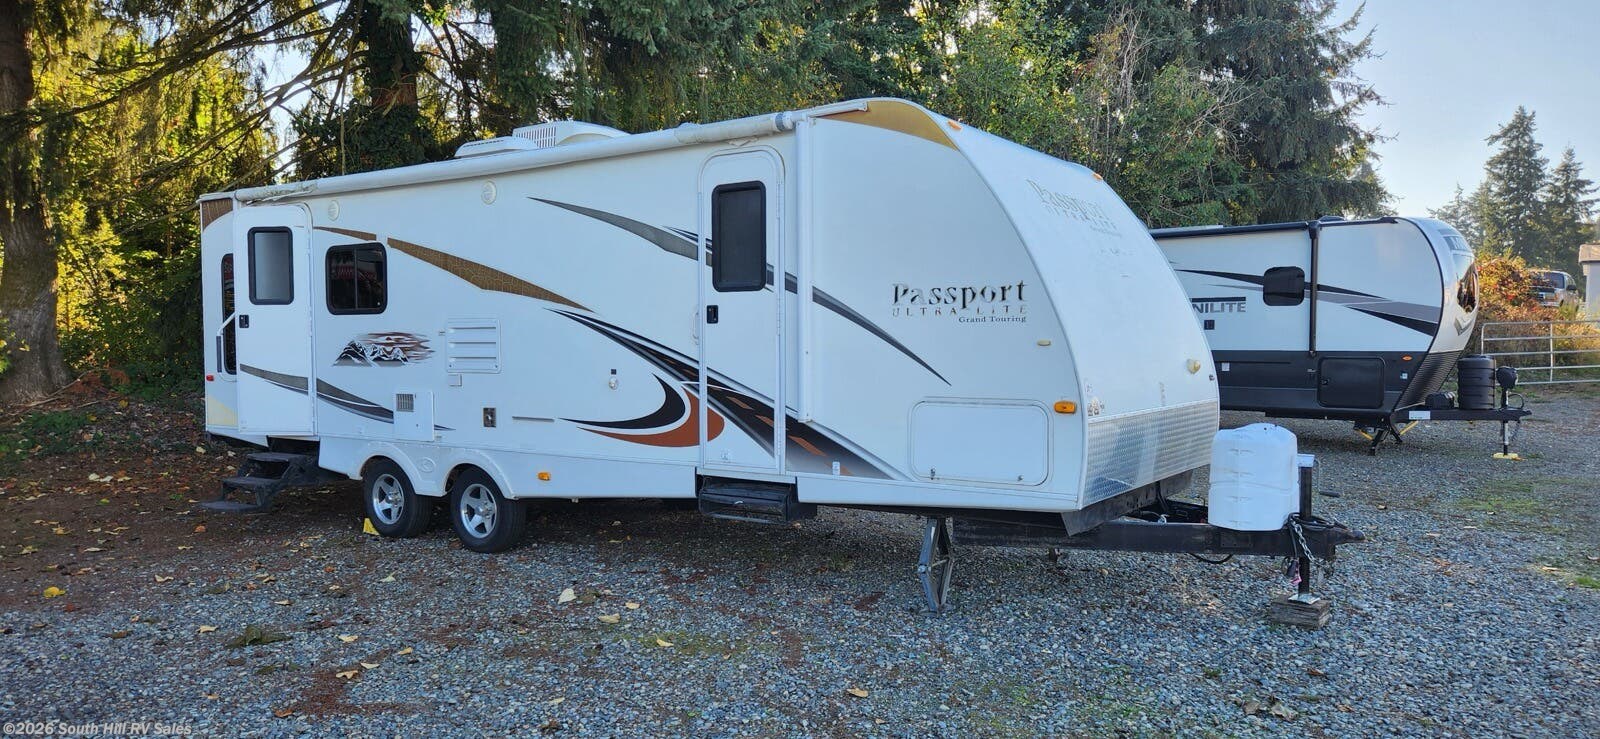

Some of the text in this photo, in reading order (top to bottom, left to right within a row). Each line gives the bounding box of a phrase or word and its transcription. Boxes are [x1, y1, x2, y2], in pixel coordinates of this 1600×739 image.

[892, 280, 1028, 309] Passport
[892, 306, 957, 317] ULTRA
[958, 315, 1027, 324] Grand Touring
